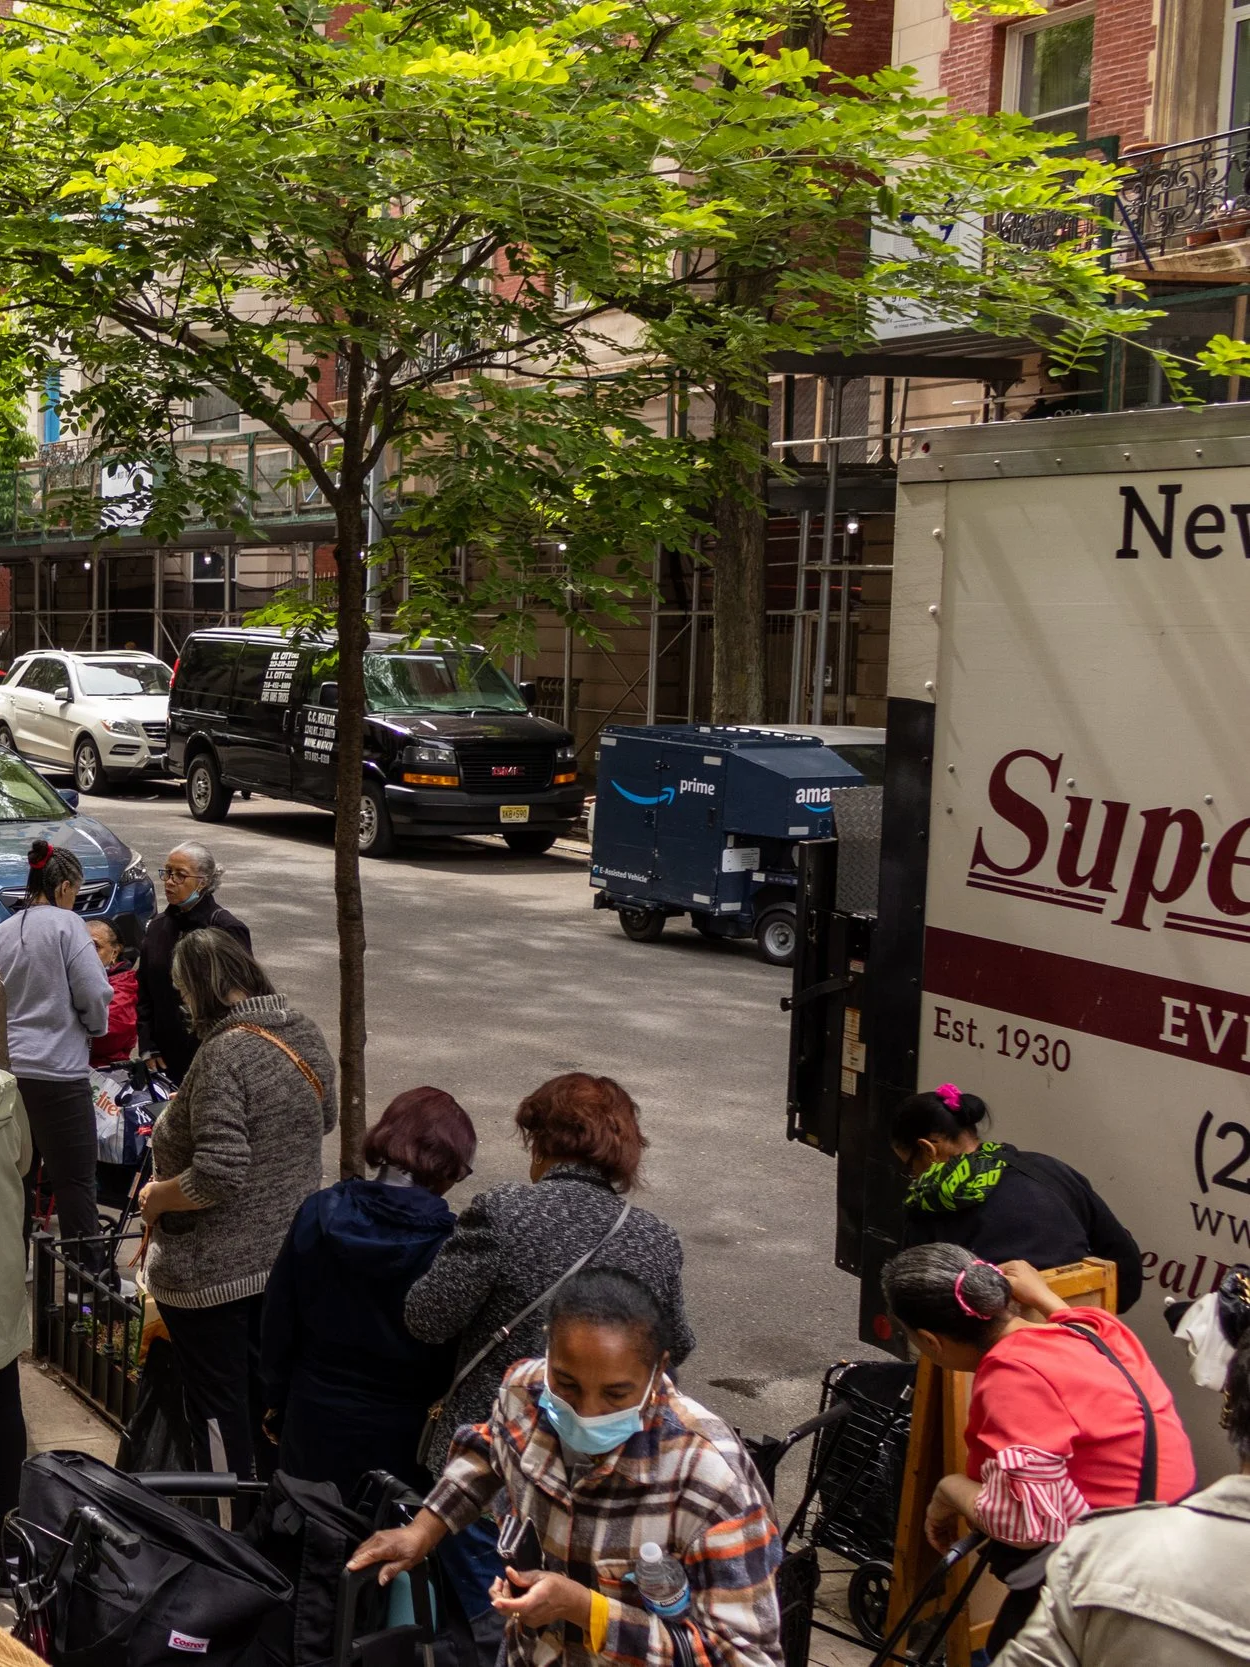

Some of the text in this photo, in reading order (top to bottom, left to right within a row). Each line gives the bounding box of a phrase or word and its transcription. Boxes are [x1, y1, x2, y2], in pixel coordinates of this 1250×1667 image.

[273, 671, 286, 679] CITY
[318, 712, 335, 727] RENTAL
[491, 766, 525, 776] GMC
[680, 778, 715, 796] prime
[599, 866, 648, 884] E-Assisted Vehicle
[1159, 996, 1250, 1063] EV
[933, 1006, 1071, 1072] Est. 1930
